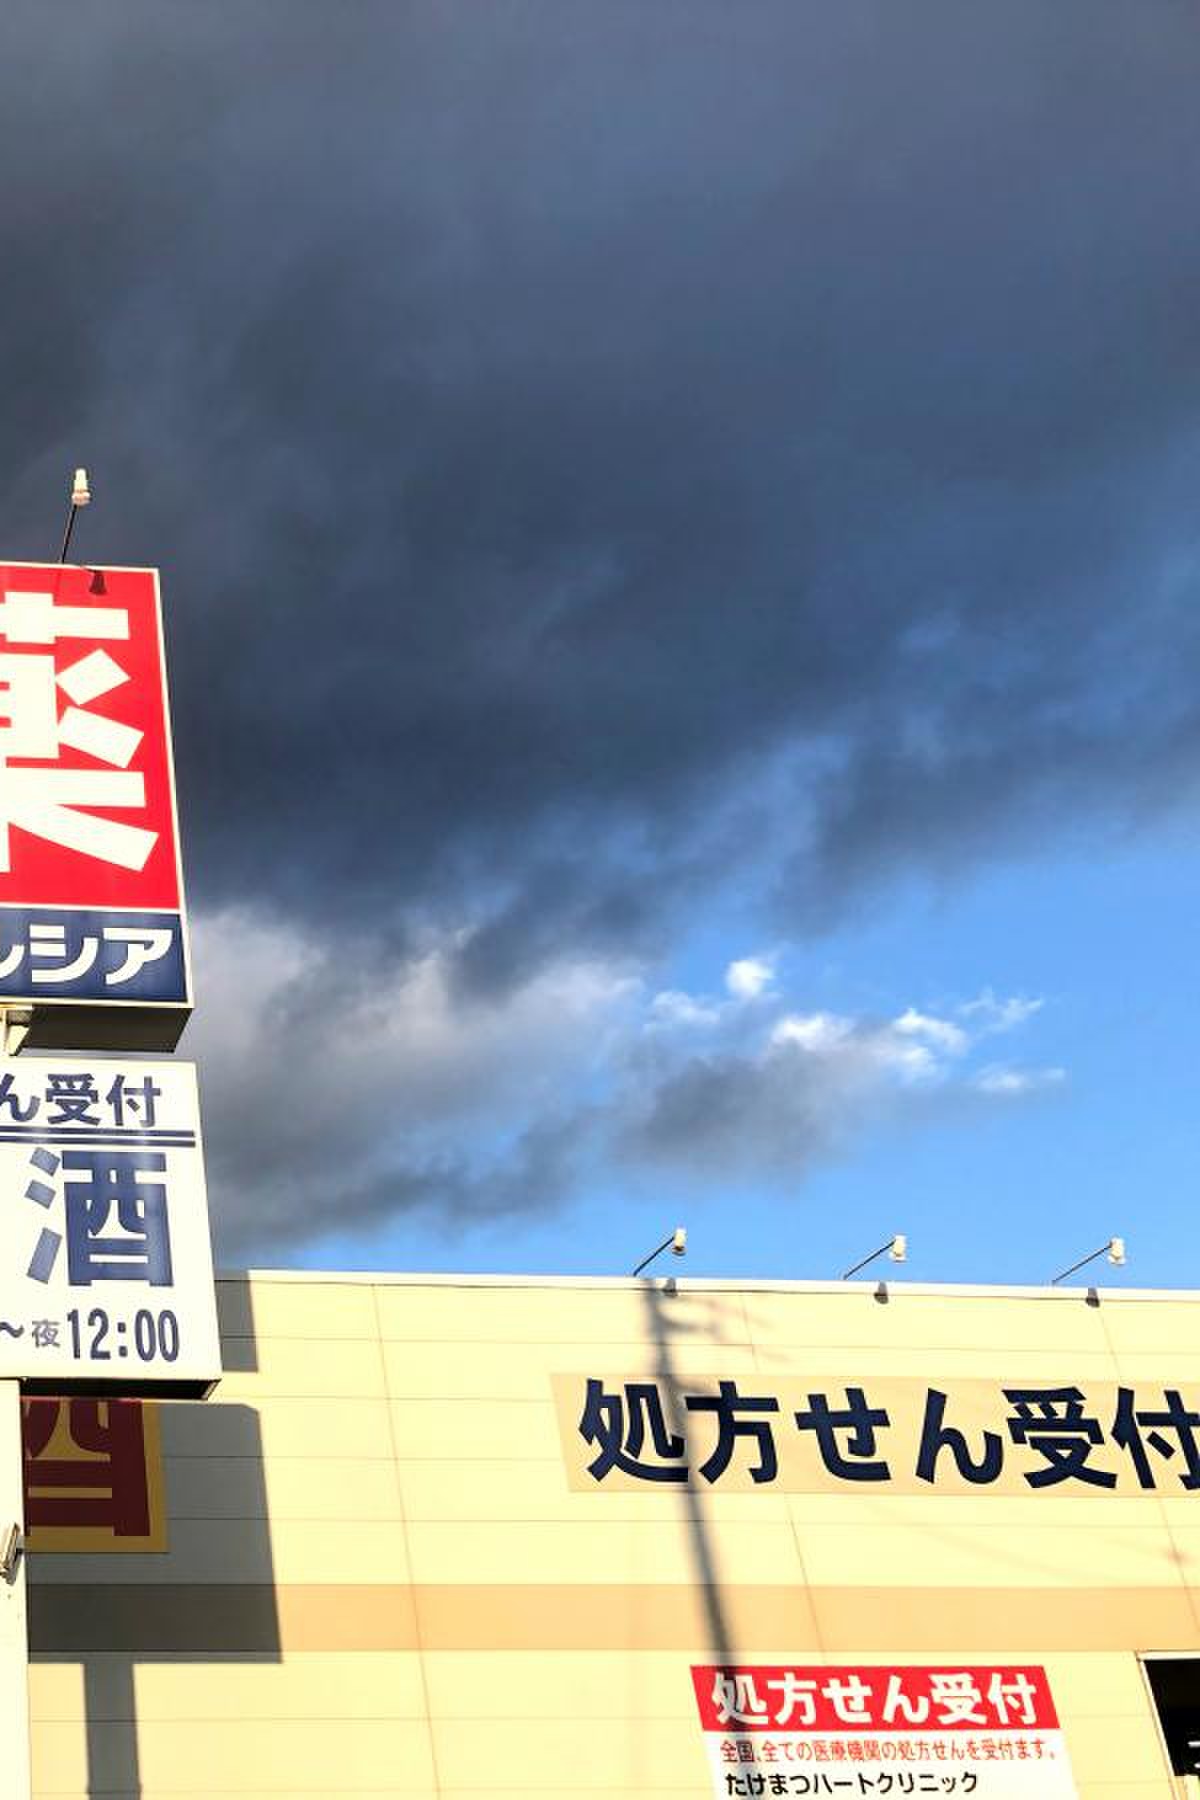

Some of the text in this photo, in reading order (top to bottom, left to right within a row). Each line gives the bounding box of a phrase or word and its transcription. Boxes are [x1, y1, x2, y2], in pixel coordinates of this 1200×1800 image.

[25, 1147, 174, 1286] 酒
[579, 1378, 1200, 1490] 処方せん受付
[712, 1672, 1037, 1725] 処方せん受付
[725, 1772, 977, 1796] たけまつハートクリニック
